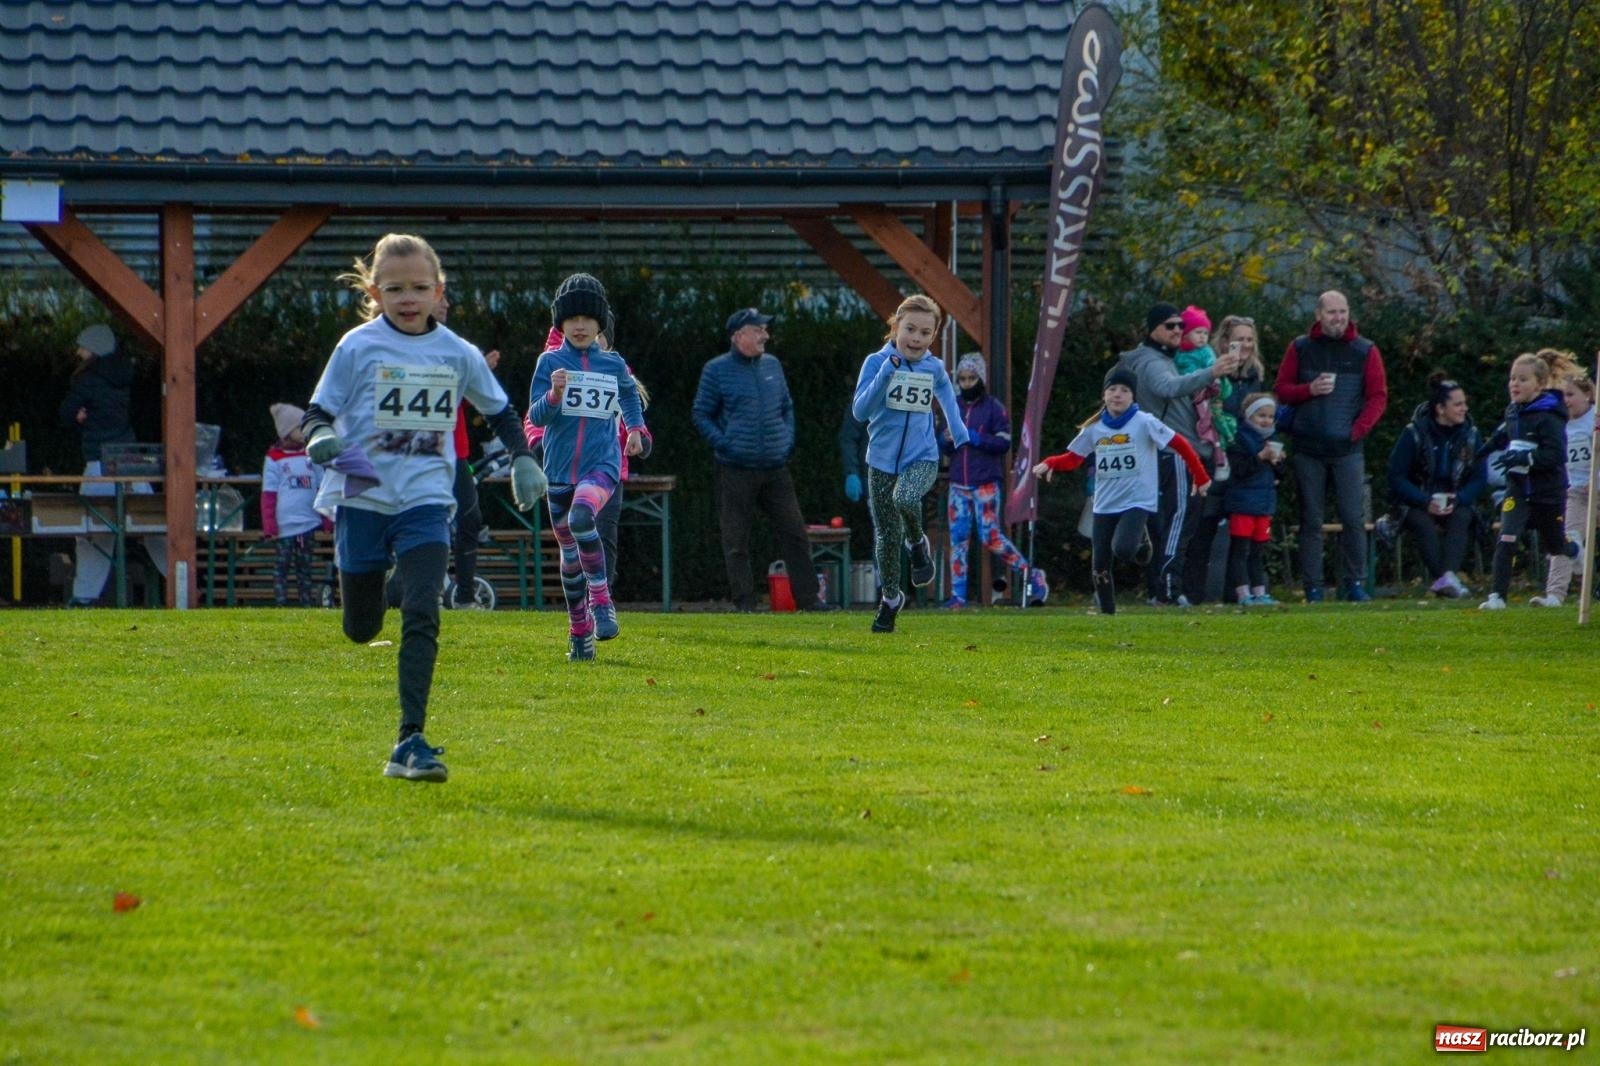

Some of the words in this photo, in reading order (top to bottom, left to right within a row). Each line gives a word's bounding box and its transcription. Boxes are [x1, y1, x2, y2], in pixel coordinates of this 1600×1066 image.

[379, 387, 453, 418] 444
[566, 387, 616, 411] 537
[888, 385, 932, 406] 453
[1098, 455, 1136, 472] 449
[1568, 447, 1591, 463] 23
